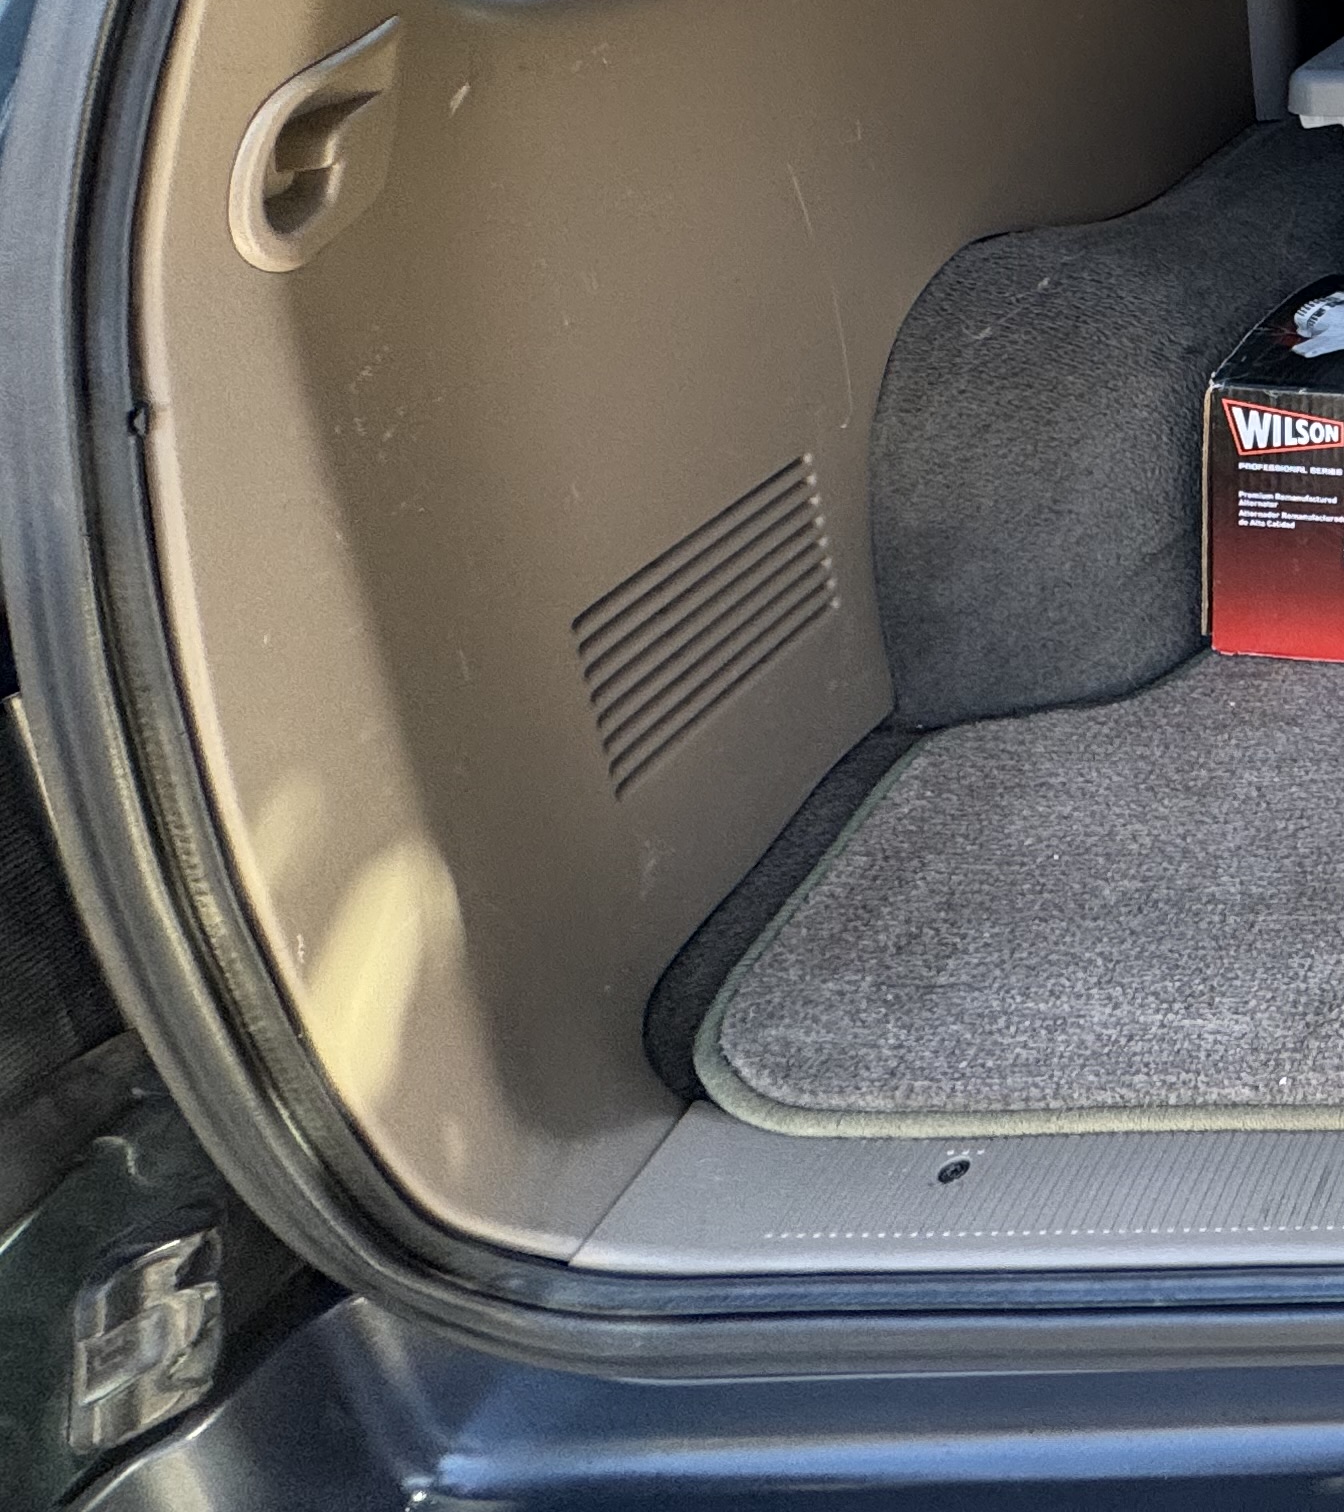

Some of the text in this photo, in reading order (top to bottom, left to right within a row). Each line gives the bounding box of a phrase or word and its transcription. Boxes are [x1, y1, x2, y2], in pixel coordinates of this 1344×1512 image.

[1231, 406, 1340, 451] WILSON
[1238, 461, 1309, 475] PROFESSIONAL
[1275, 492, 1338, 505] Remanufactured
